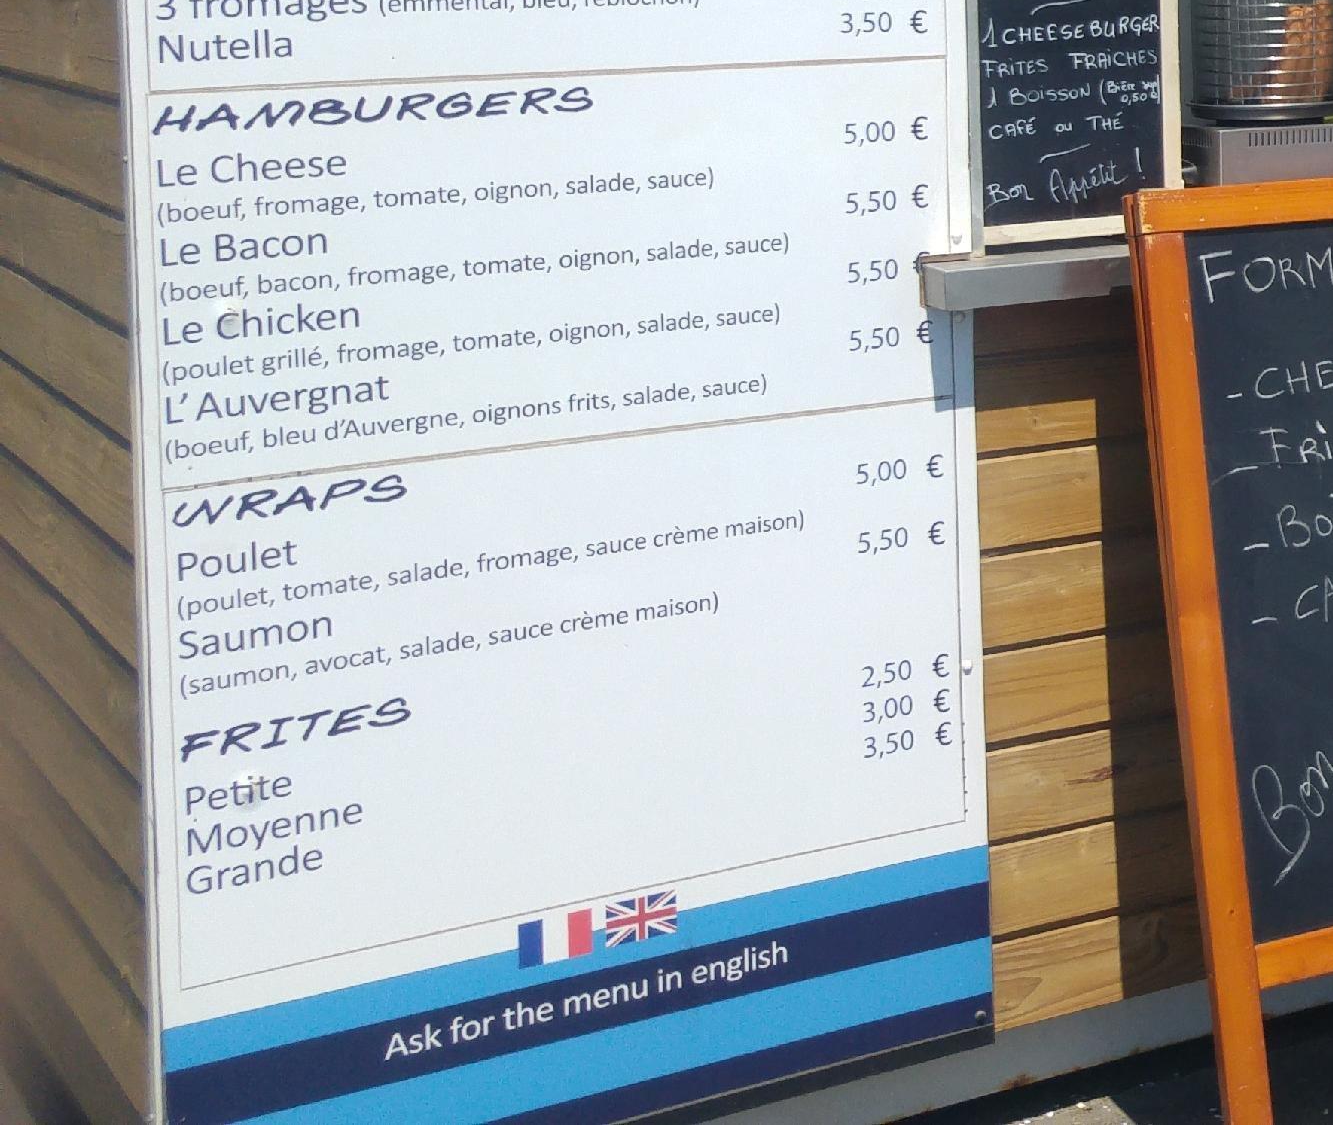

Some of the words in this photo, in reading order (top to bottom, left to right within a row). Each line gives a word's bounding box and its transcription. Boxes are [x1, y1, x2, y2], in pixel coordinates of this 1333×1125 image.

[159, 29, 292, 63] Nutella
[151, 87, 593, 136] HAMBURGERS
[844, 120, 895, 147] 5,00
[910, 116, 928, 140] €
[1055, 123, 1073, 133] ou
[157, 160, 197, 187] Le
[211, 153, 346, 183] Cheese
[158, 197, 245, 228] (boeuf,
[254, 196, 365, 216] fromage,
[373, 187, 466, 208] tomate,
[475, 181, 558, 203] oignon,
[566, 172, 640, 194] salade,
[648, 167, 713, 190] sauce)
[172, 474, 407, 528] WRAPS
[178, 541, 297, 581] Poulet
[179, 613, 333, 659] Saumon
[181, 697, 411, 763] FRITES
[186, 776, 292, 816] Petite
[186, 800, 363, 857] Moyenne
[186, 845, 323, 894] Grande
[384, 1030, 443, 1062] Ask
[449, 1014, 496, 1044] for
[502, 1002, 555, 1031] the
[563, 979, 649, 1018] menu
[656, 968, 683, 995] in
[690, 942, 789, 986] english
